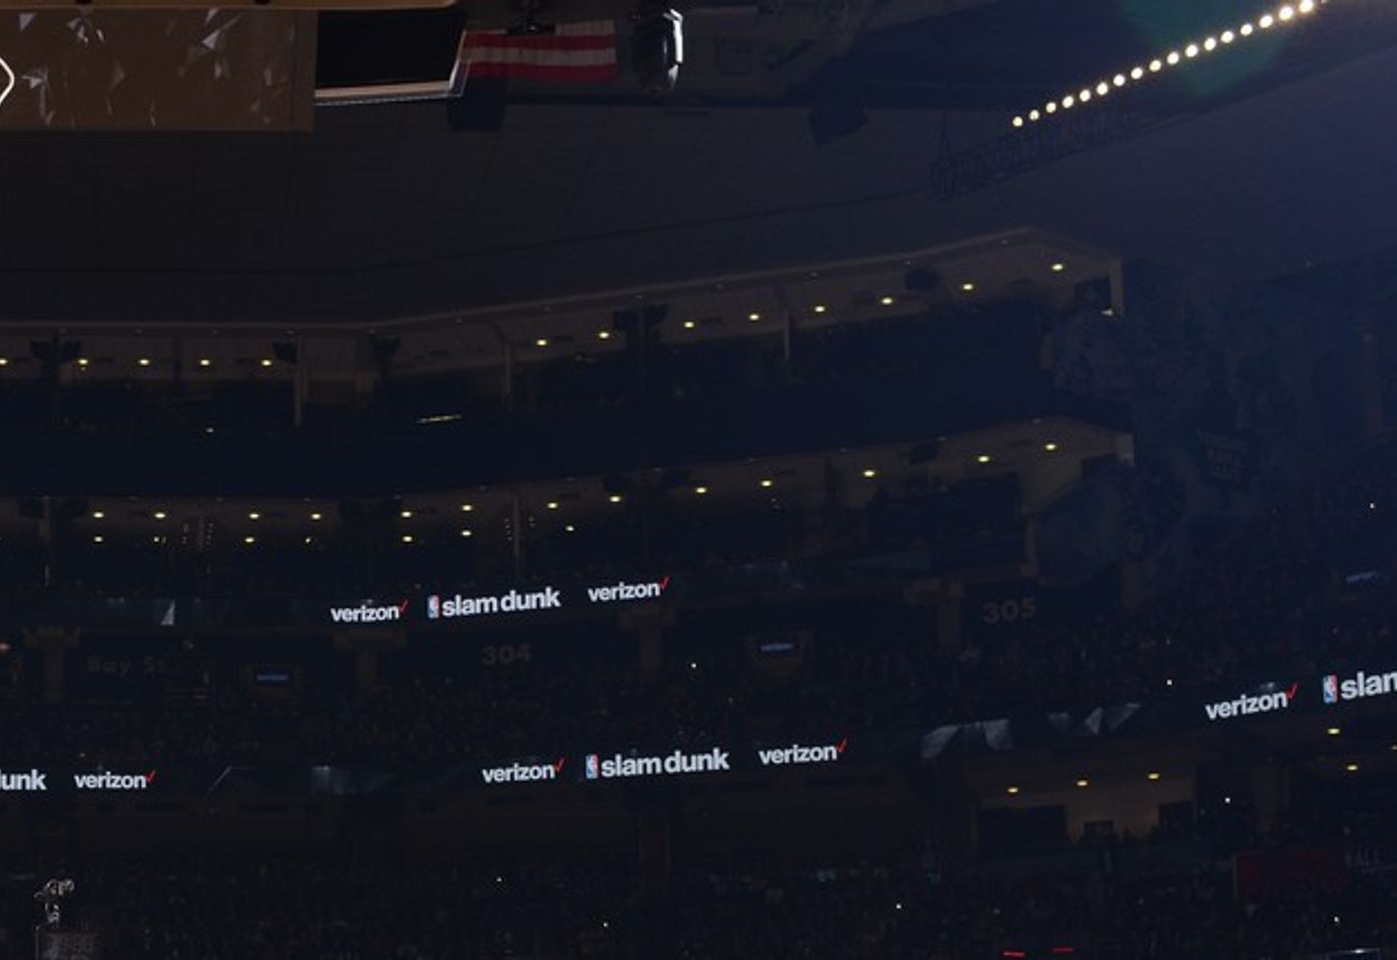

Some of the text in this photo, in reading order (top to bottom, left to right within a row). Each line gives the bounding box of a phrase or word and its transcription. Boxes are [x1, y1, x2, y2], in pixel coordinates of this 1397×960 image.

[442, 586, 561, 617] slam dunk
[588, 581, 660, 602] verizon
[331, 602, 400, 622] verizon
[1205, 693, 1287, 720] verizon
[601, 747, 730, 778] slam dunk
[759, 744, 837, 765] verizon
[74, 771, 147, 789] verizon
[483, 762, 555, 783] verizon
